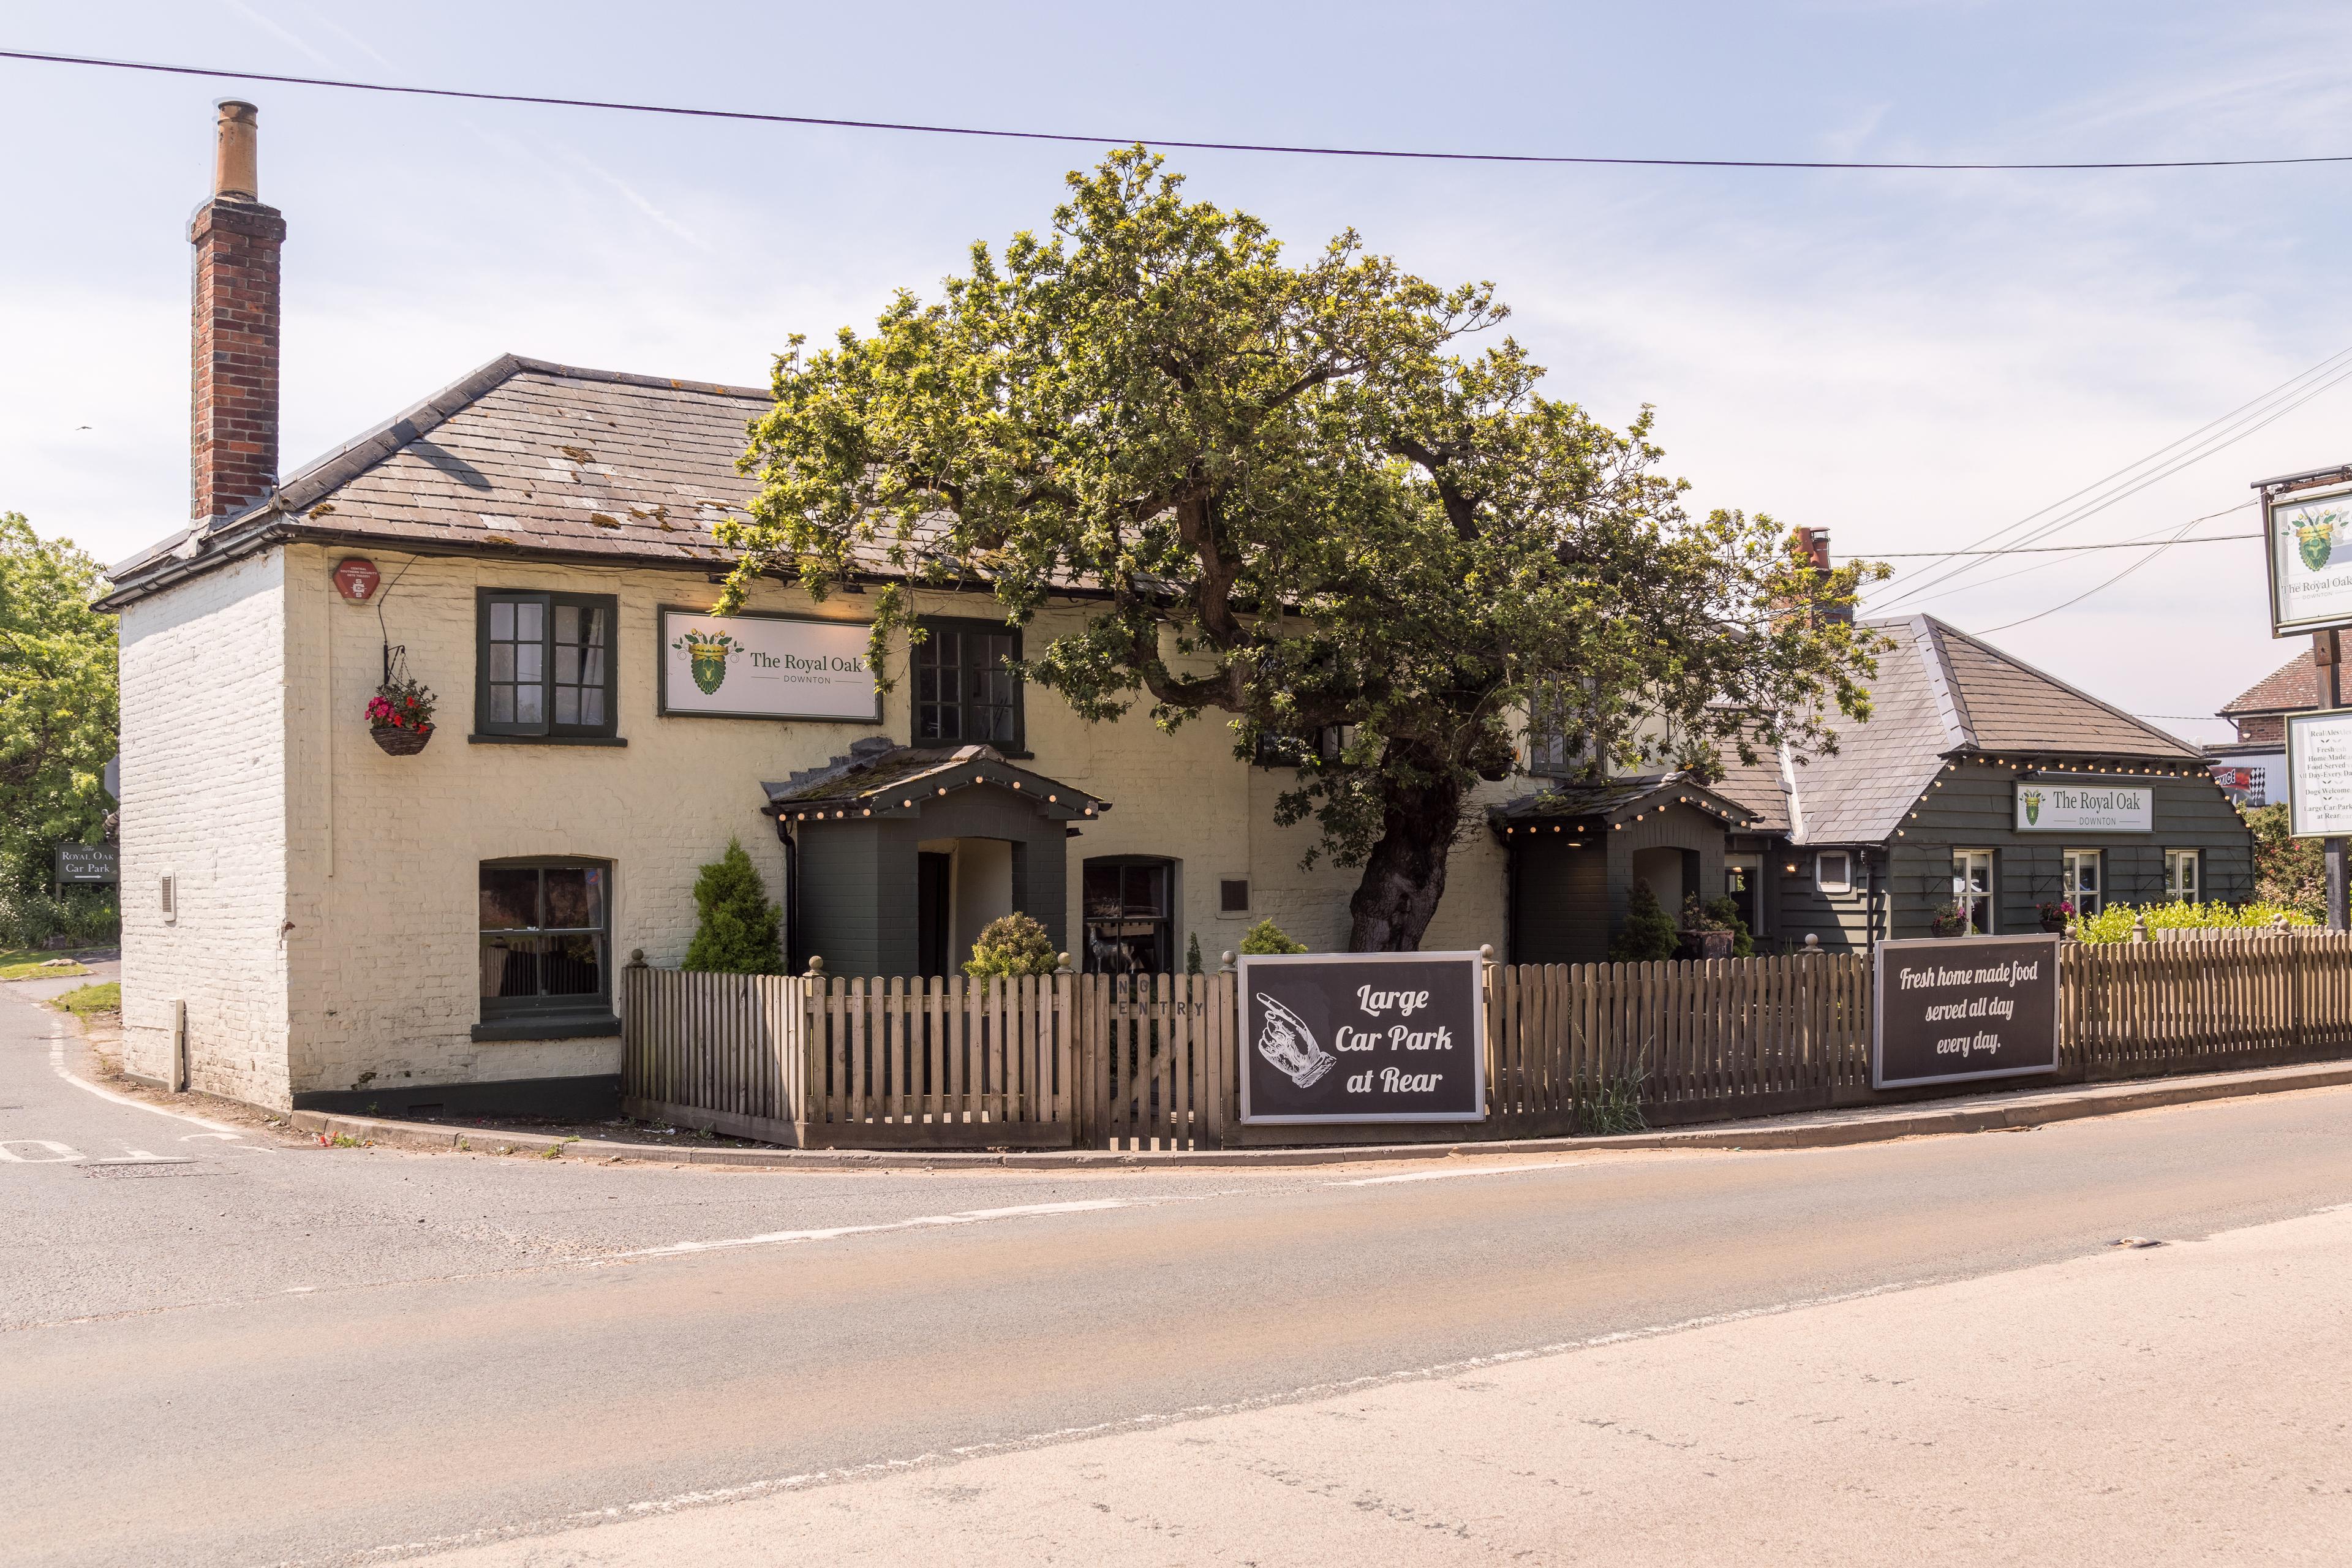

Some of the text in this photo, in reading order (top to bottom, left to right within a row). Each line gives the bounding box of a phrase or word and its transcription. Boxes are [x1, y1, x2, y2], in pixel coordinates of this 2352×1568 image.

[2282, 576, 2352, 594] The Royal Oak
[750, 652, 862, 674] The Royal Oak
[784, 675, 831, 684] DOWNTON
[2053, 791, 2141, 813] The Royal Oak
[2079, 817, 2116, 826] DOWNTON
[62, 851, 114, 860] ROYAL OAK
[66, 864, 110, 872] Car Park
[1900, 960, 2038, 990] Fresh home made food
[1119, 979, 1150, 994] NO
[1119, 1001, 1203, 1016] ENTRY
[1357, 984, 1429, 1017] Large
[1925, 996, 2014, 1022] served all day
[1336, 1025, 1453, 1052] Car Park
[1937, 1030, 2001, 1058] every day.
[1346, 1066, 1443, 1093] at Rear
